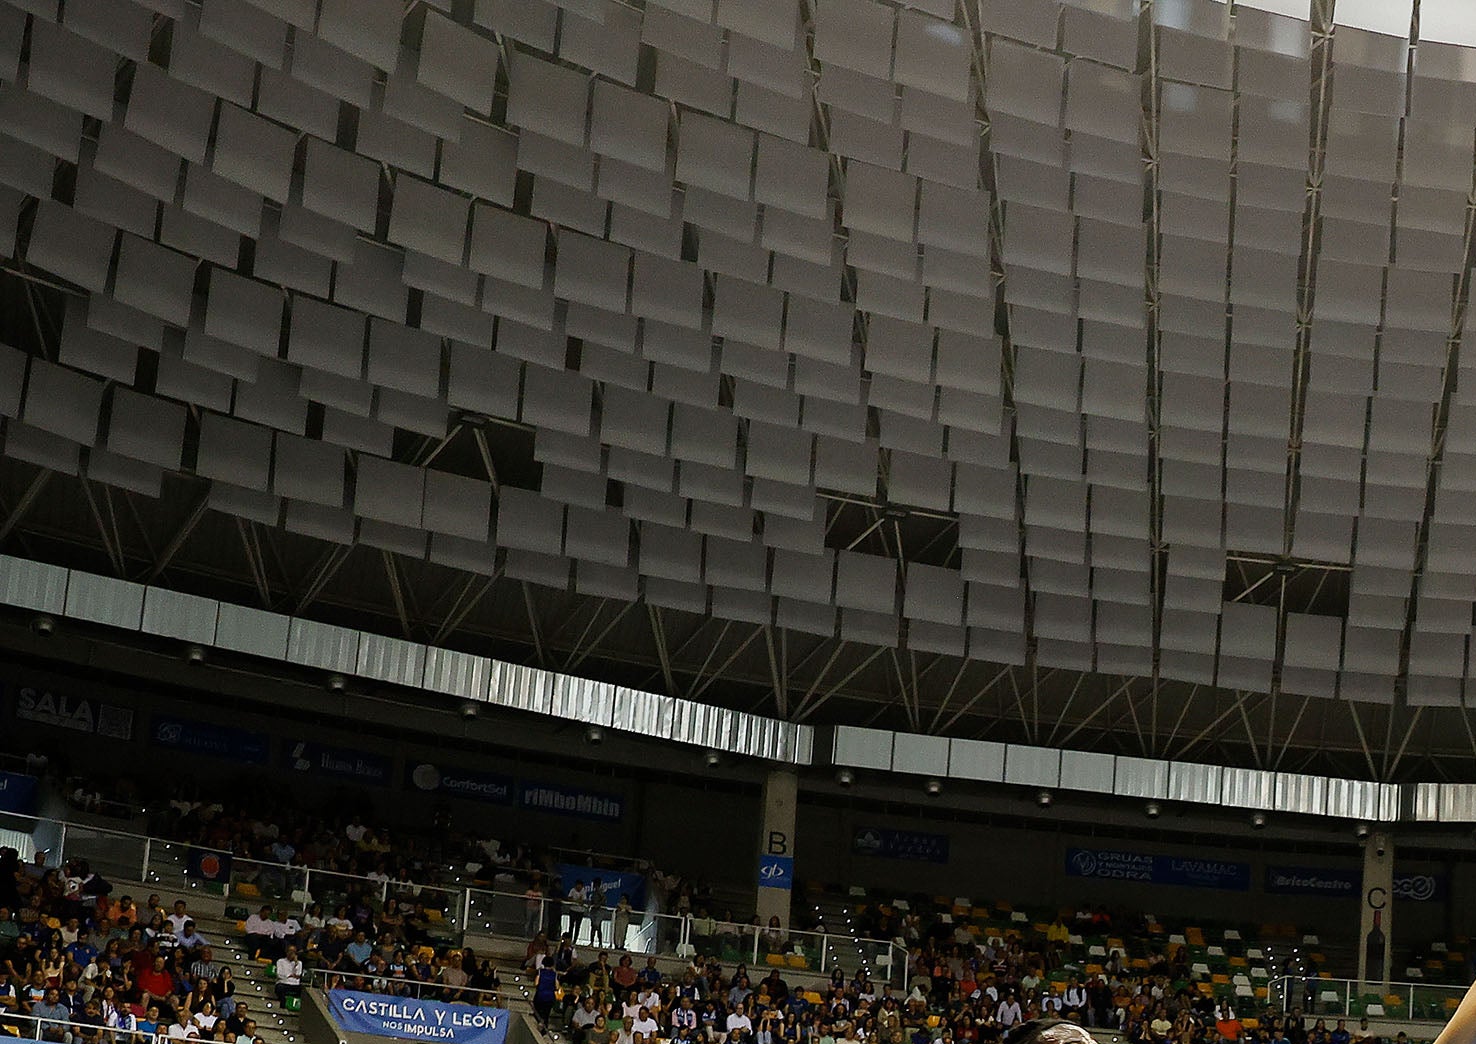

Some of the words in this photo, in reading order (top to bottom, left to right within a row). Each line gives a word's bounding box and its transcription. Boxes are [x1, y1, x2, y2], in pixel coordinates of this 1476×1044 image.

[18, 687, 94, 722] SALA
[769, 832, 786, 854] B
[1368, 888, 1385, 908] C
[342, 997, 426, 1021] CASTILLA
[434, 1009, 446, 1026] Y
[453, 1010, 497, 1030] LEÓN
[382, 1020, 403, 1030] NOS
[403, 1023, 455, 1038] IMPULSA
